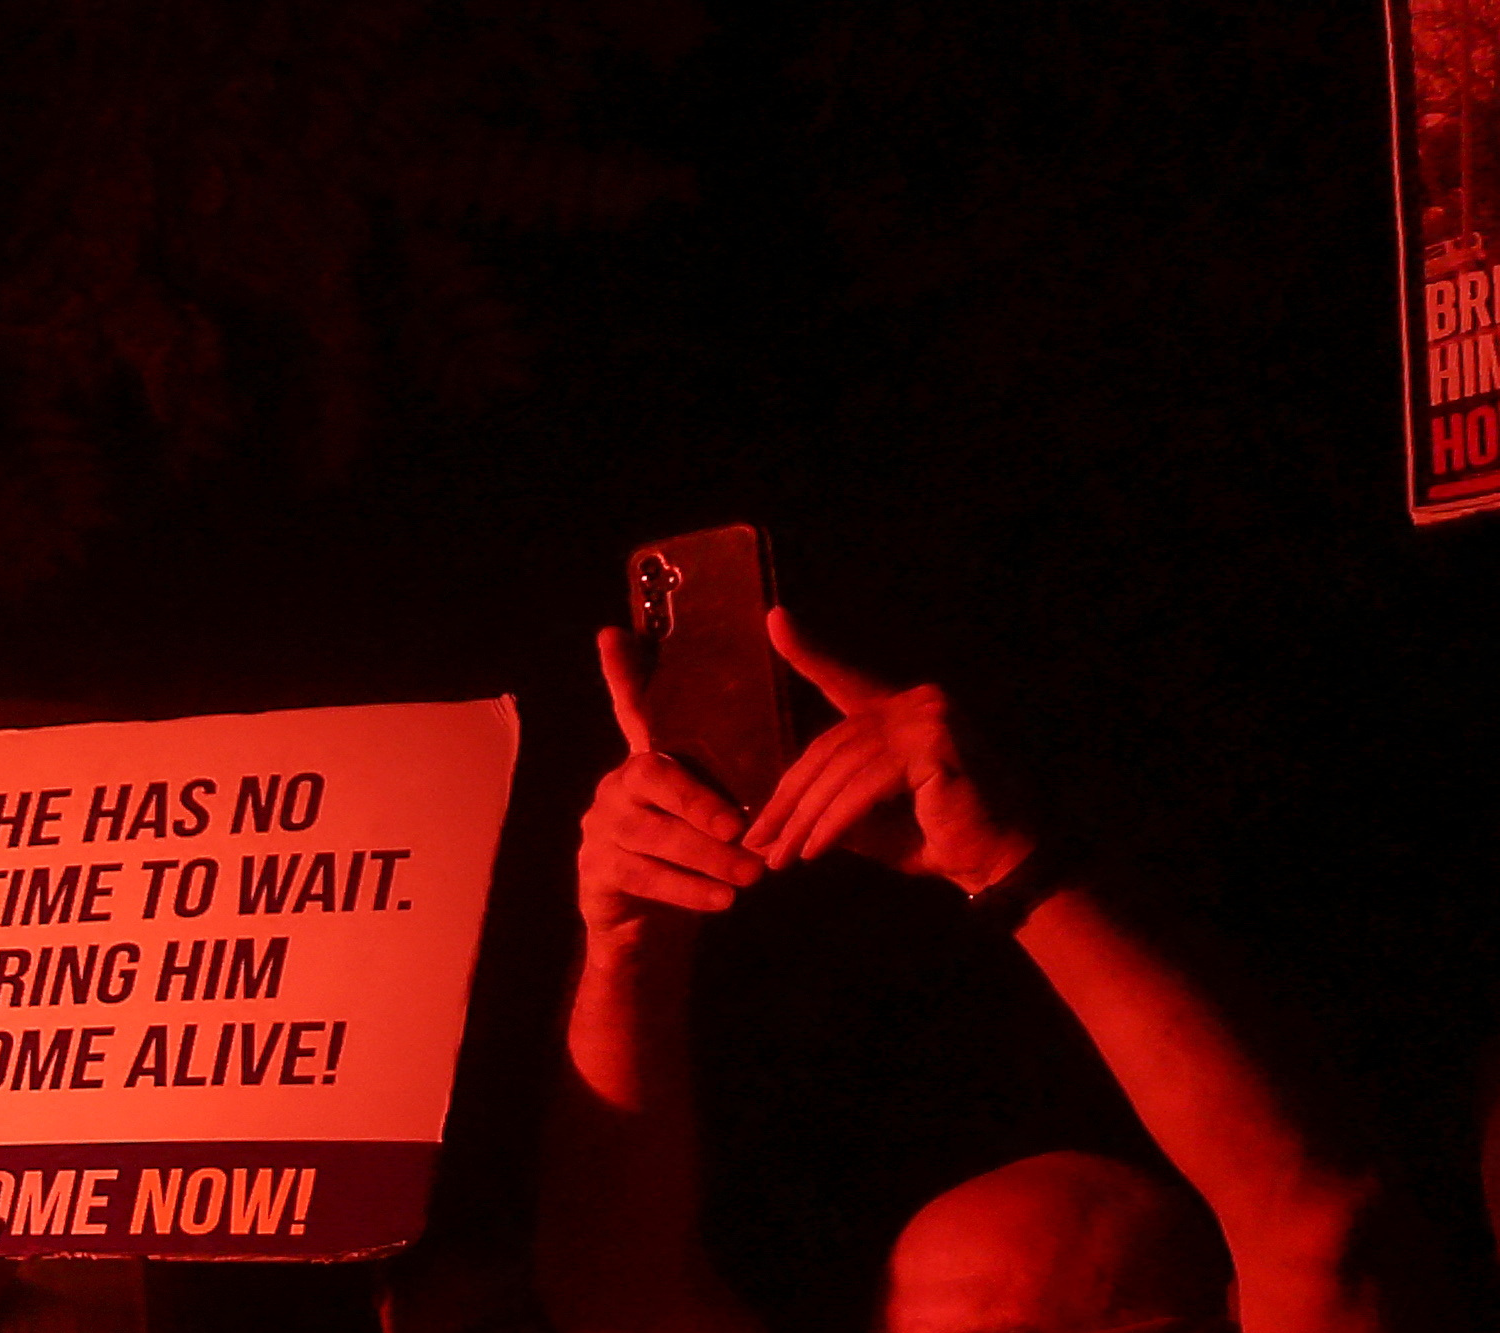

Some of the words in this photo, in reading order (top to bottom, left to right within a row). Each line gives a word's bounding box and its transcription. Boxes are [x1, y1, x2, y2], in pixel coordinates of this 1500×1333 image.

[82, 778, 213, 846] HAS
[229, 771, 326, 835] NO
[140, 857, 220, 921] TO
[237, 848, 415, 915] WAIT.
[155, 936, 289, 1003] HIM
[124, 1020, 348, 1091] ALIVE!
[131, 1167, 315, 1238] NOW!
